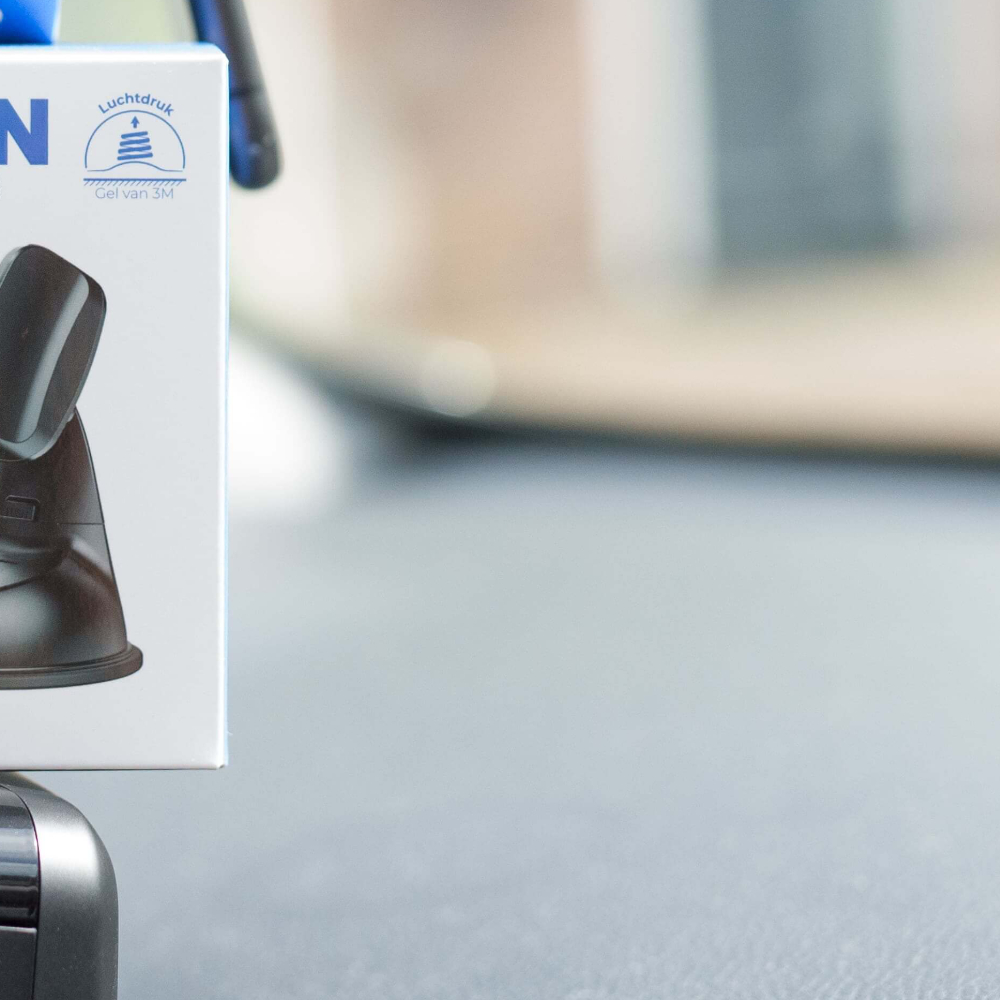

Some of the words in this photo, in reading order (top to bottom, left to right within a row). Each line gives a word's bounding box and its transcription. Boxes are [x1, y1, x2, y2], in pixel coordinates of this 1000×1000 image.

[98, 93, 174, 116] Luchtdruk
[95, 187, 118, 199] Gel
[122, 189, 148, 199] van
[152, 187, 174, 199] 3M
